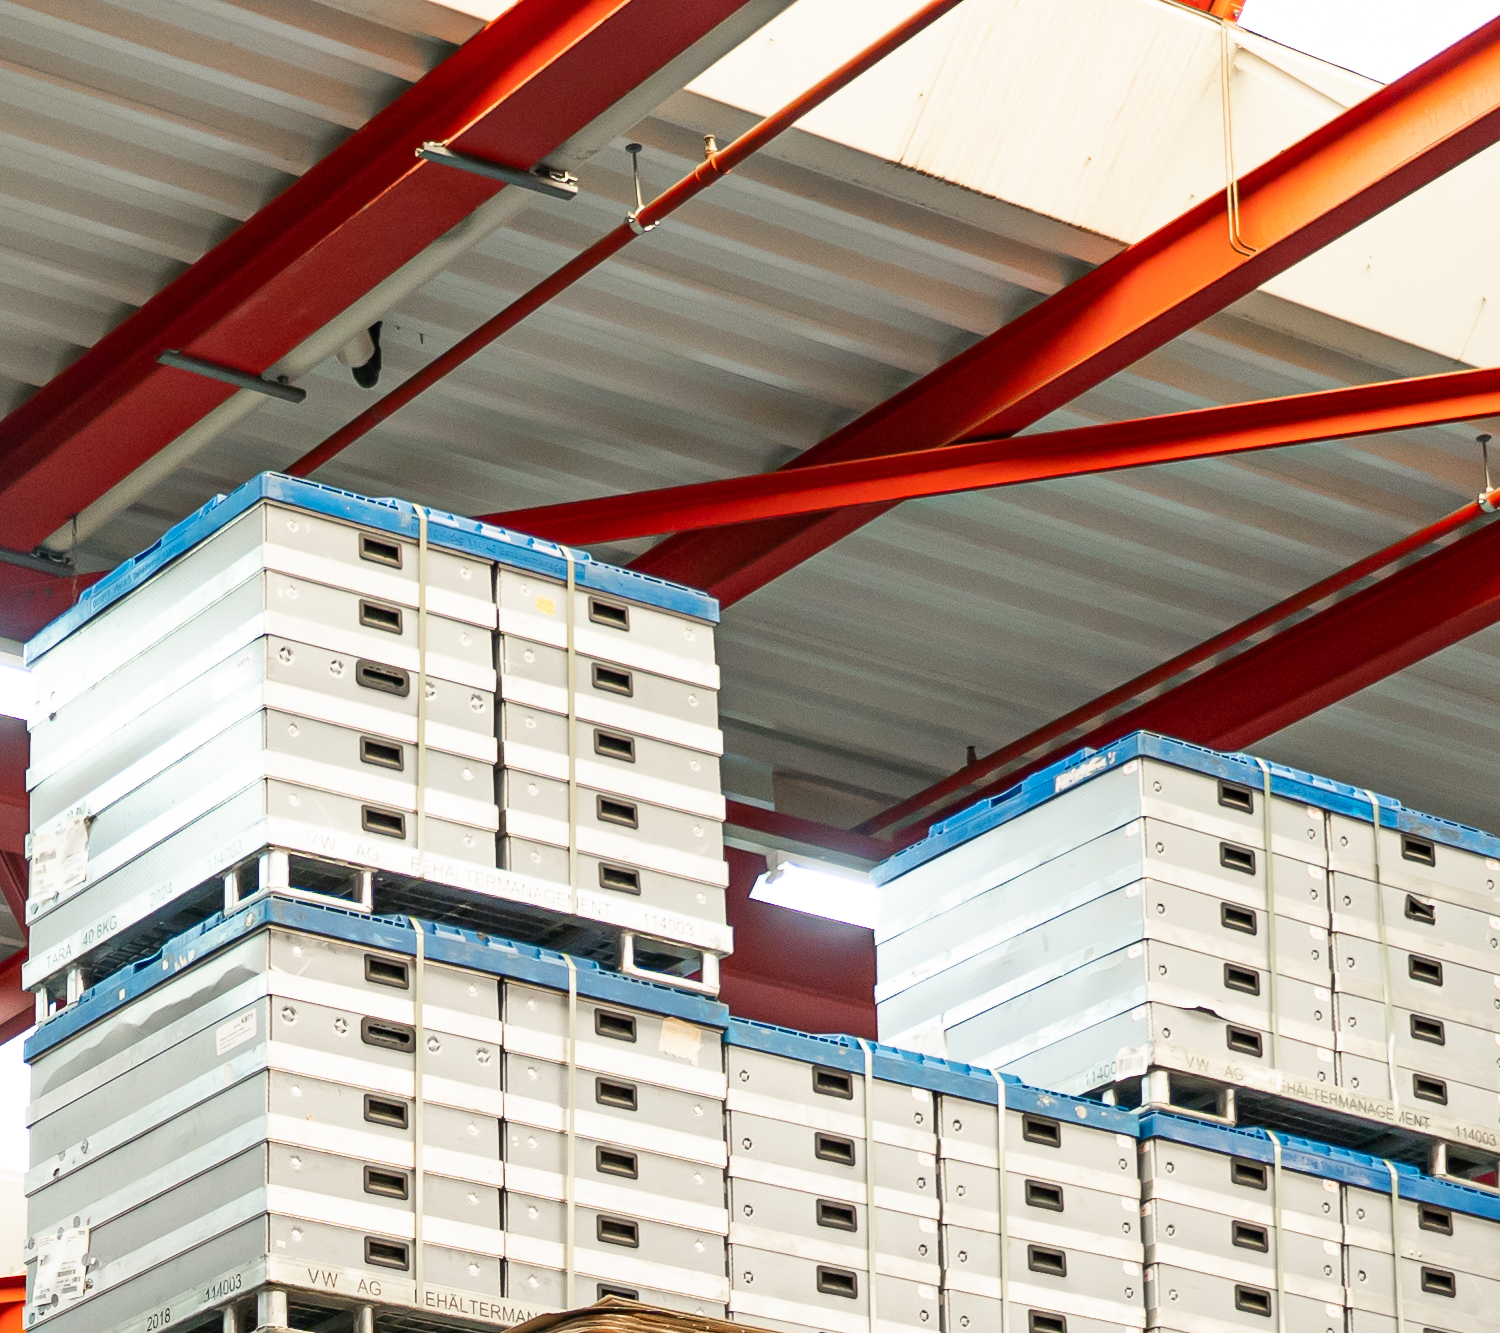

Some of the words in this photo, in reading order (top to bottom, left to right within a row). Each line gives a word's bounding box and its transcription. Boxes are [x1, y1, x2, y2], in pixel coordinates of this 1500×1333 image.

[307, 832, 336, 852] VW
[355, 844, 379, 863] AG
[643, 911, 694, 937] 114003
[1085, 1061, 1117, 1086] 11400
[1185, 1056, 1210, 1071] VW
[1224, 1066, 1244, 1081] AG
[1455, 1125, 1497, 1146] 114003
[146, 1308, 171, 1332] 2018
[205, 1273, 241, 1301] 114003
[307, 1268, 338, 1287] VW
[357, 1278, 381, 1296] AG
